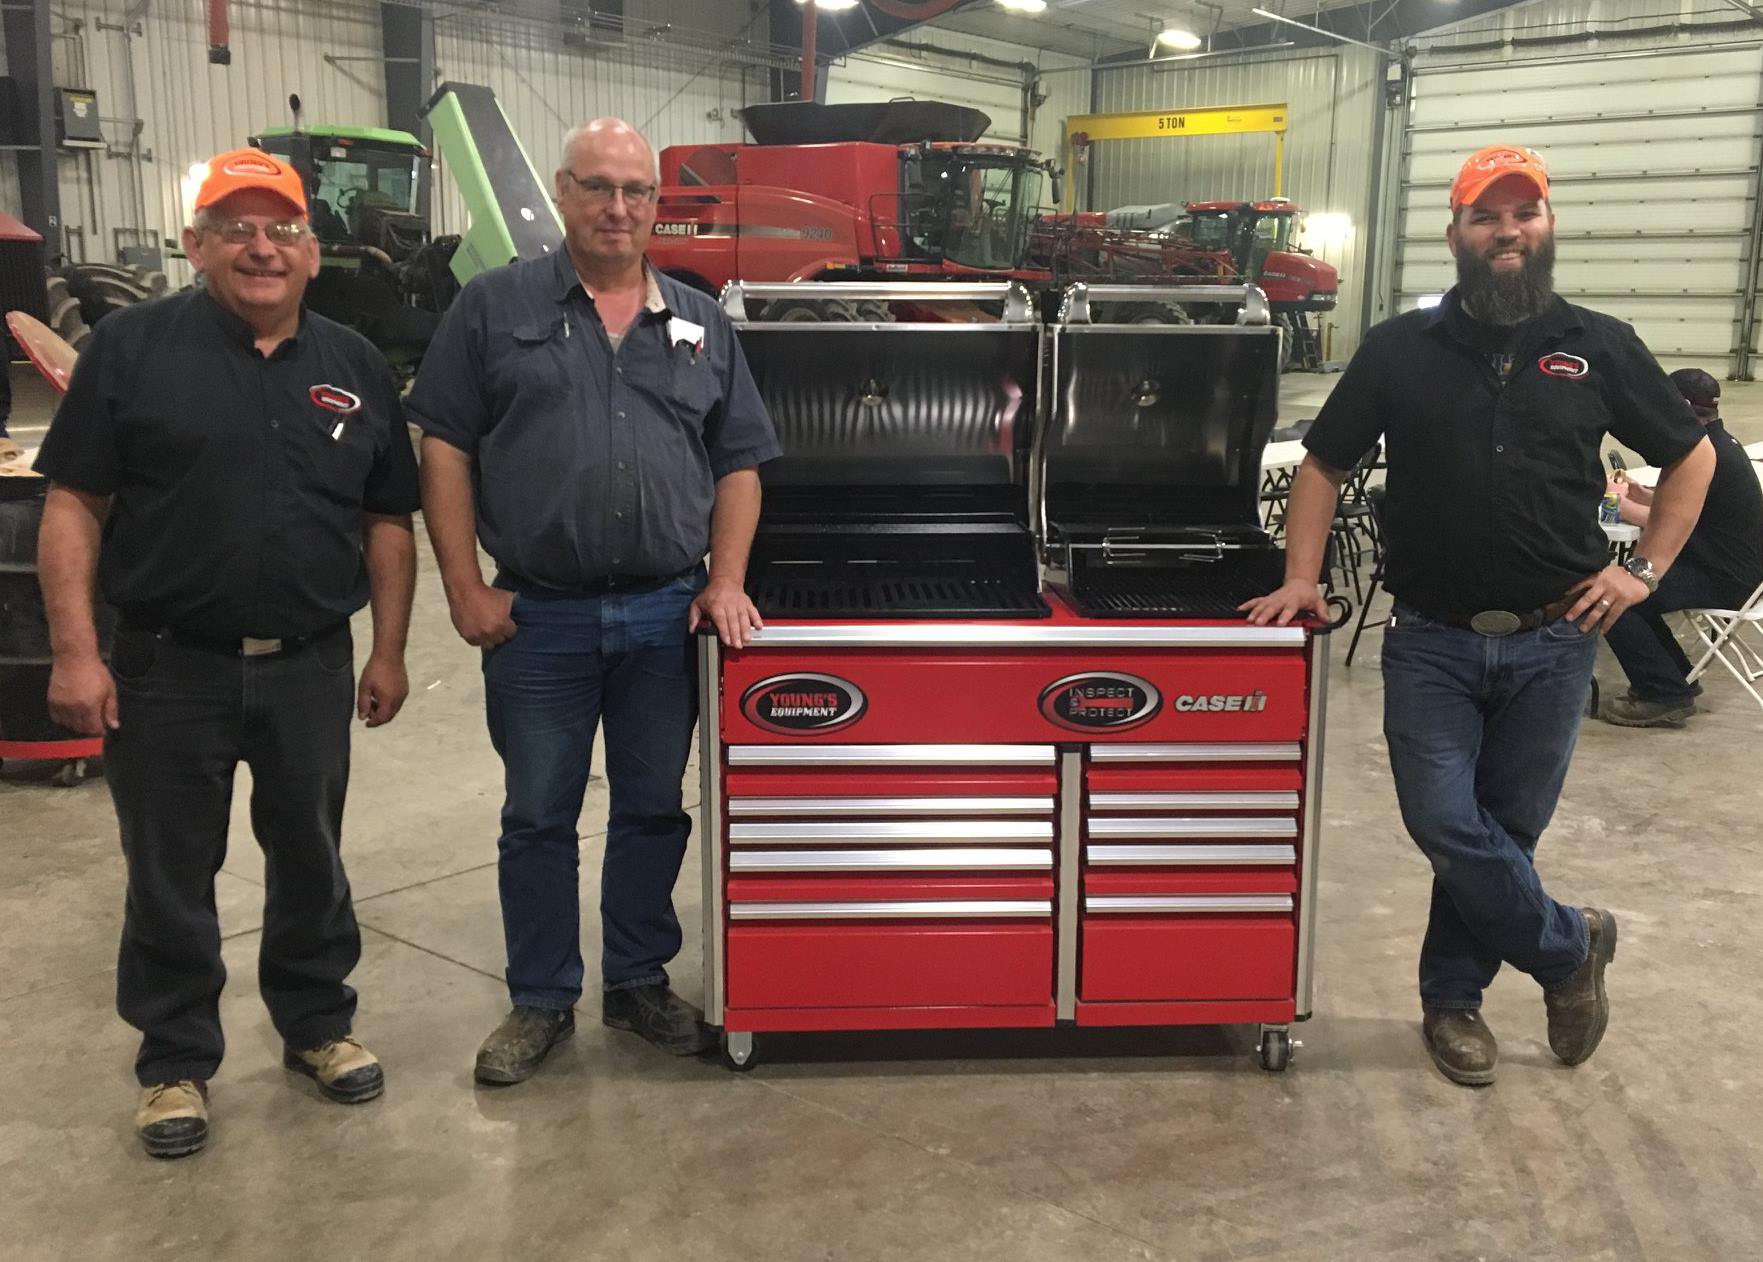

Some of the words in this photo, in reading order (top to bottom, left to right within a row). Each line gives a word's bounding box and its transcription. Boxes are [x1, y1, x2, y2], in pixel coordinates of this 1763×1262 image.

[1158, 118, 1165, 129] 5
[1166, 117, 1185, 129] TON
[1069, 687, 1134, 698] INSPECT
[769, 692, 838, 707] YOUNG'S
[769, 707, 838, 717] EQUIPMENT
[1069, 707, 1132, 717] PROTECT
